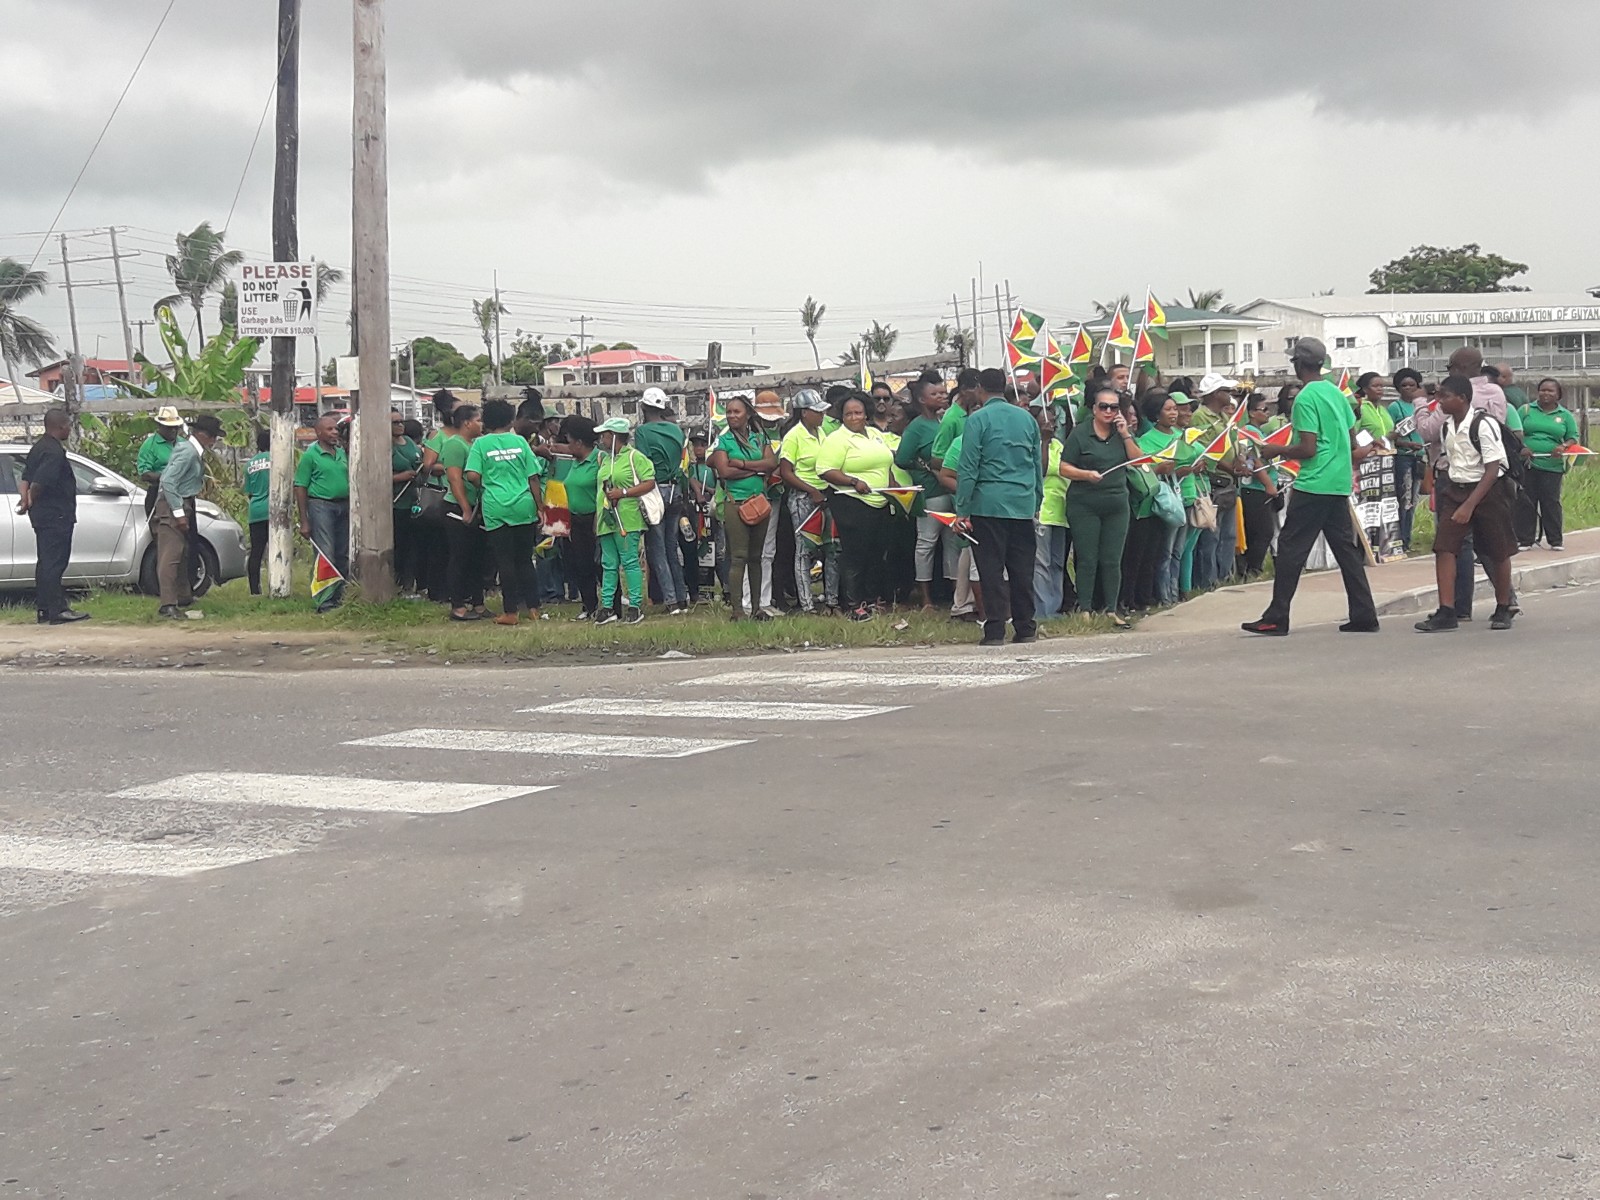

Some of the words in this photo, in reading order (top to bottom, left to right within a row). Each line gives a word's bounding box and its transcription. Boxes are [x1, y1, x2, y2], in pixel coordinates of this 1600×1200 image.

[243, 265, 312, 279] PLEASE
[243, 282, 256, 291] DO
[259, 281, 278, 291] NOT
[244, 293, 279, 303] LITTER
[241, 307, 258, 315] USE
[241, 316, 268, 325] Garbage
[1409, 313, 1450, 325] MUSLIM
[1456, 312, 1485, 324] YOUTH
[1490, 310, 1552, 322] ORGANIZATION
[1557, 309, 1568, 320] OF
[1571, 308, 1600, 320] GUYAN
[241, 327, 273, 335] LITTERING
[290, 327, 315, 335] $10,000
